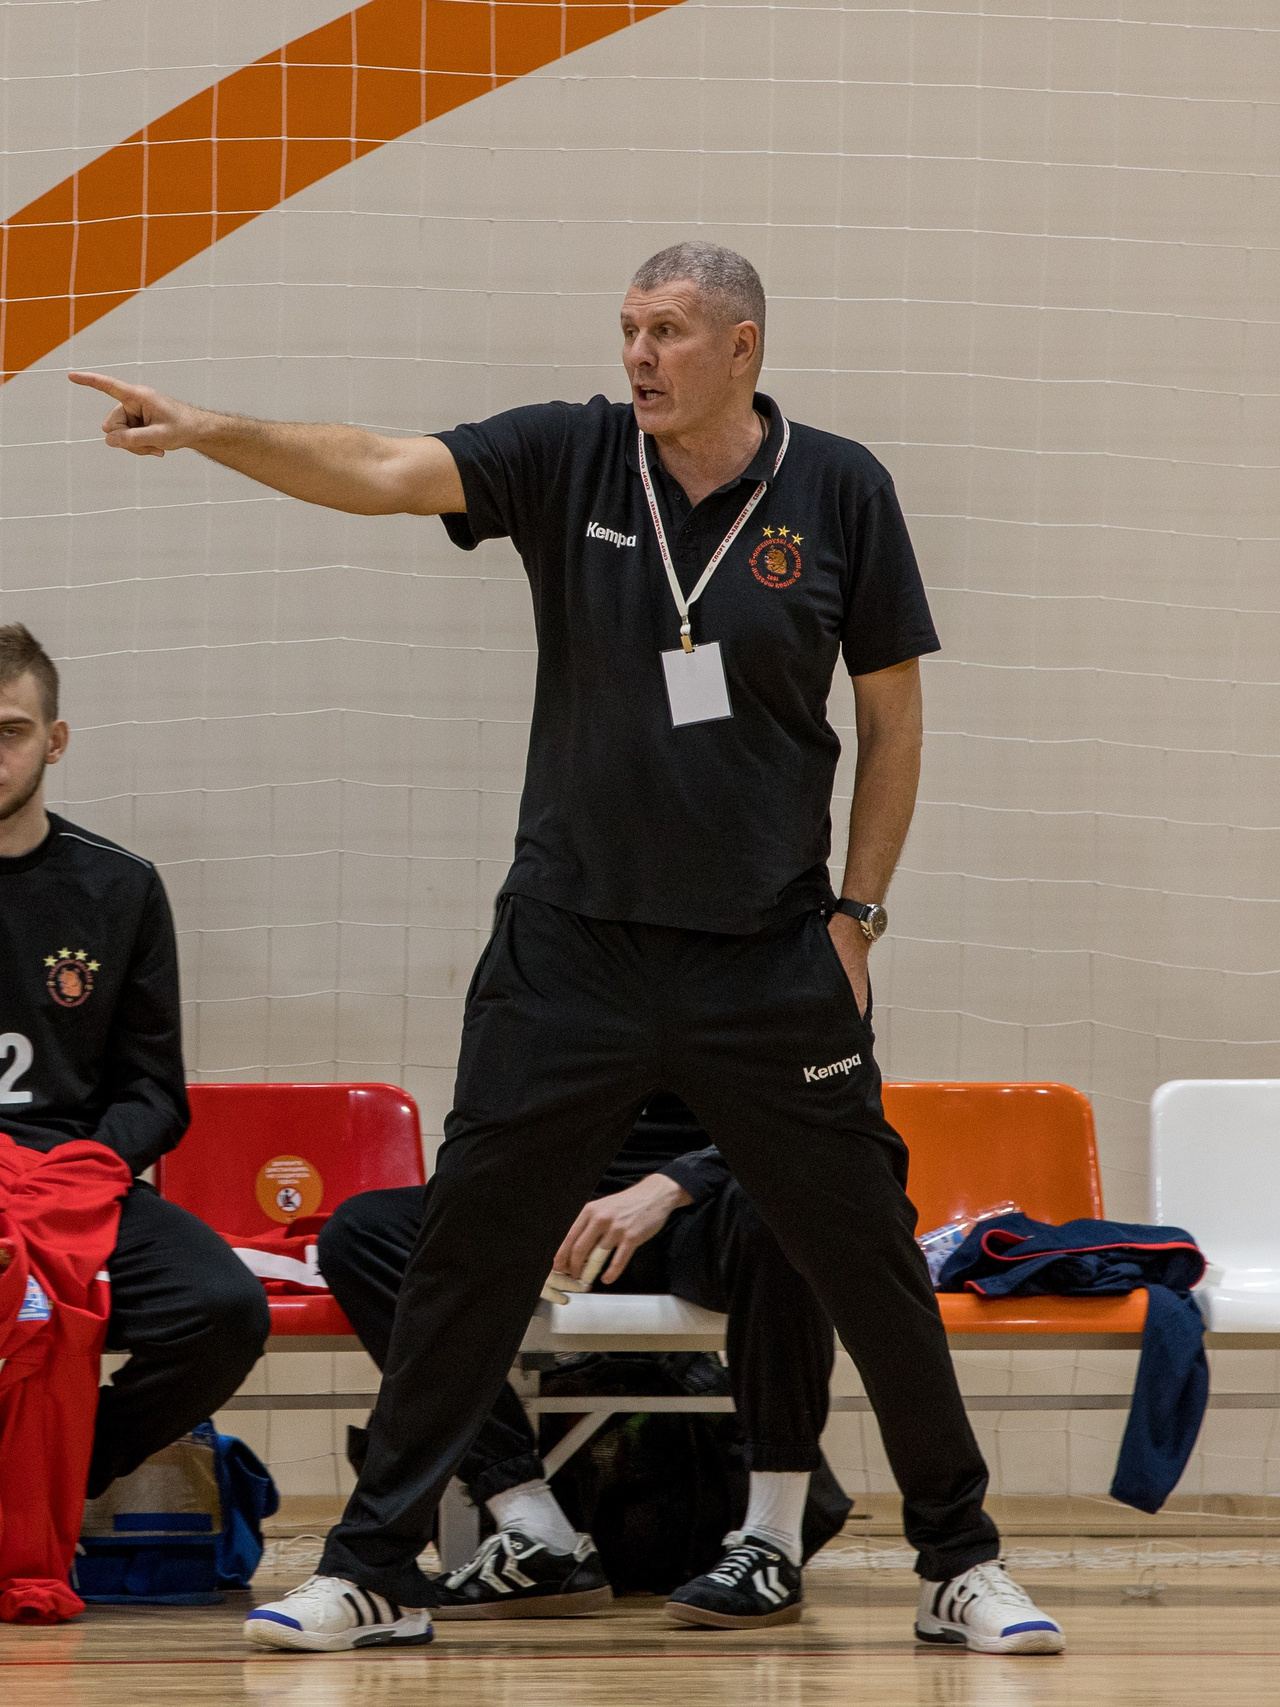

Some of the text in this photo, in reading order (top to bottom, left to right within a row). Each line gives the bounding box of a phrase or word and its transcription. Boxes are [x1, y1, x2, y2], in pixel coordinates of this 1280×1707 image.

[586, 521, 637, 548] Kempa
[660, 541, 669, 561] СПОРТ
[711, 544, 726, 563] СПОРТ
[803, 1053, 862, 1083] Kempa
